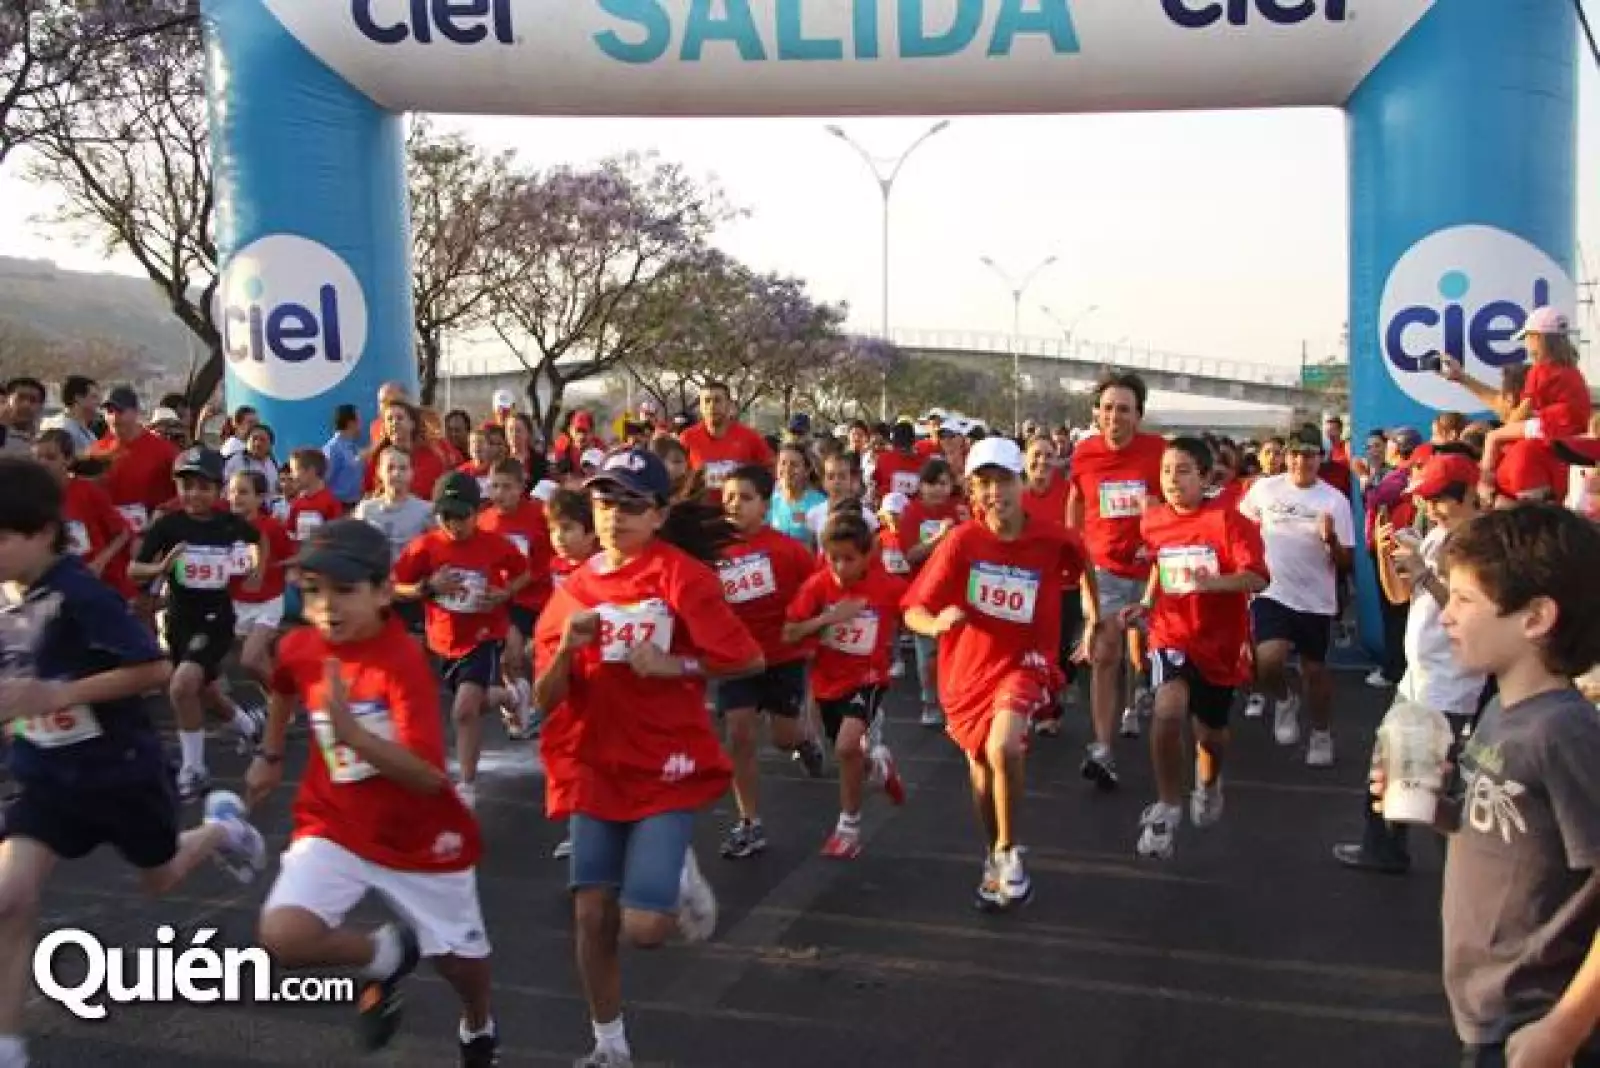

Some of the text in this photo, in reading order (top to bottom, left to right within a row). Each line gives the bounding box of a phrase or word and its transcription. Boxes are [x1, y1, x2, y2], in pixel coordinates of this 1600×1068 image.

[592, 0, 1081, 63] SALIDA
[224, 276, 342, 363] ciel
[184, 563, 224, 581] 991
[980, 585, 1023, 611] 190
